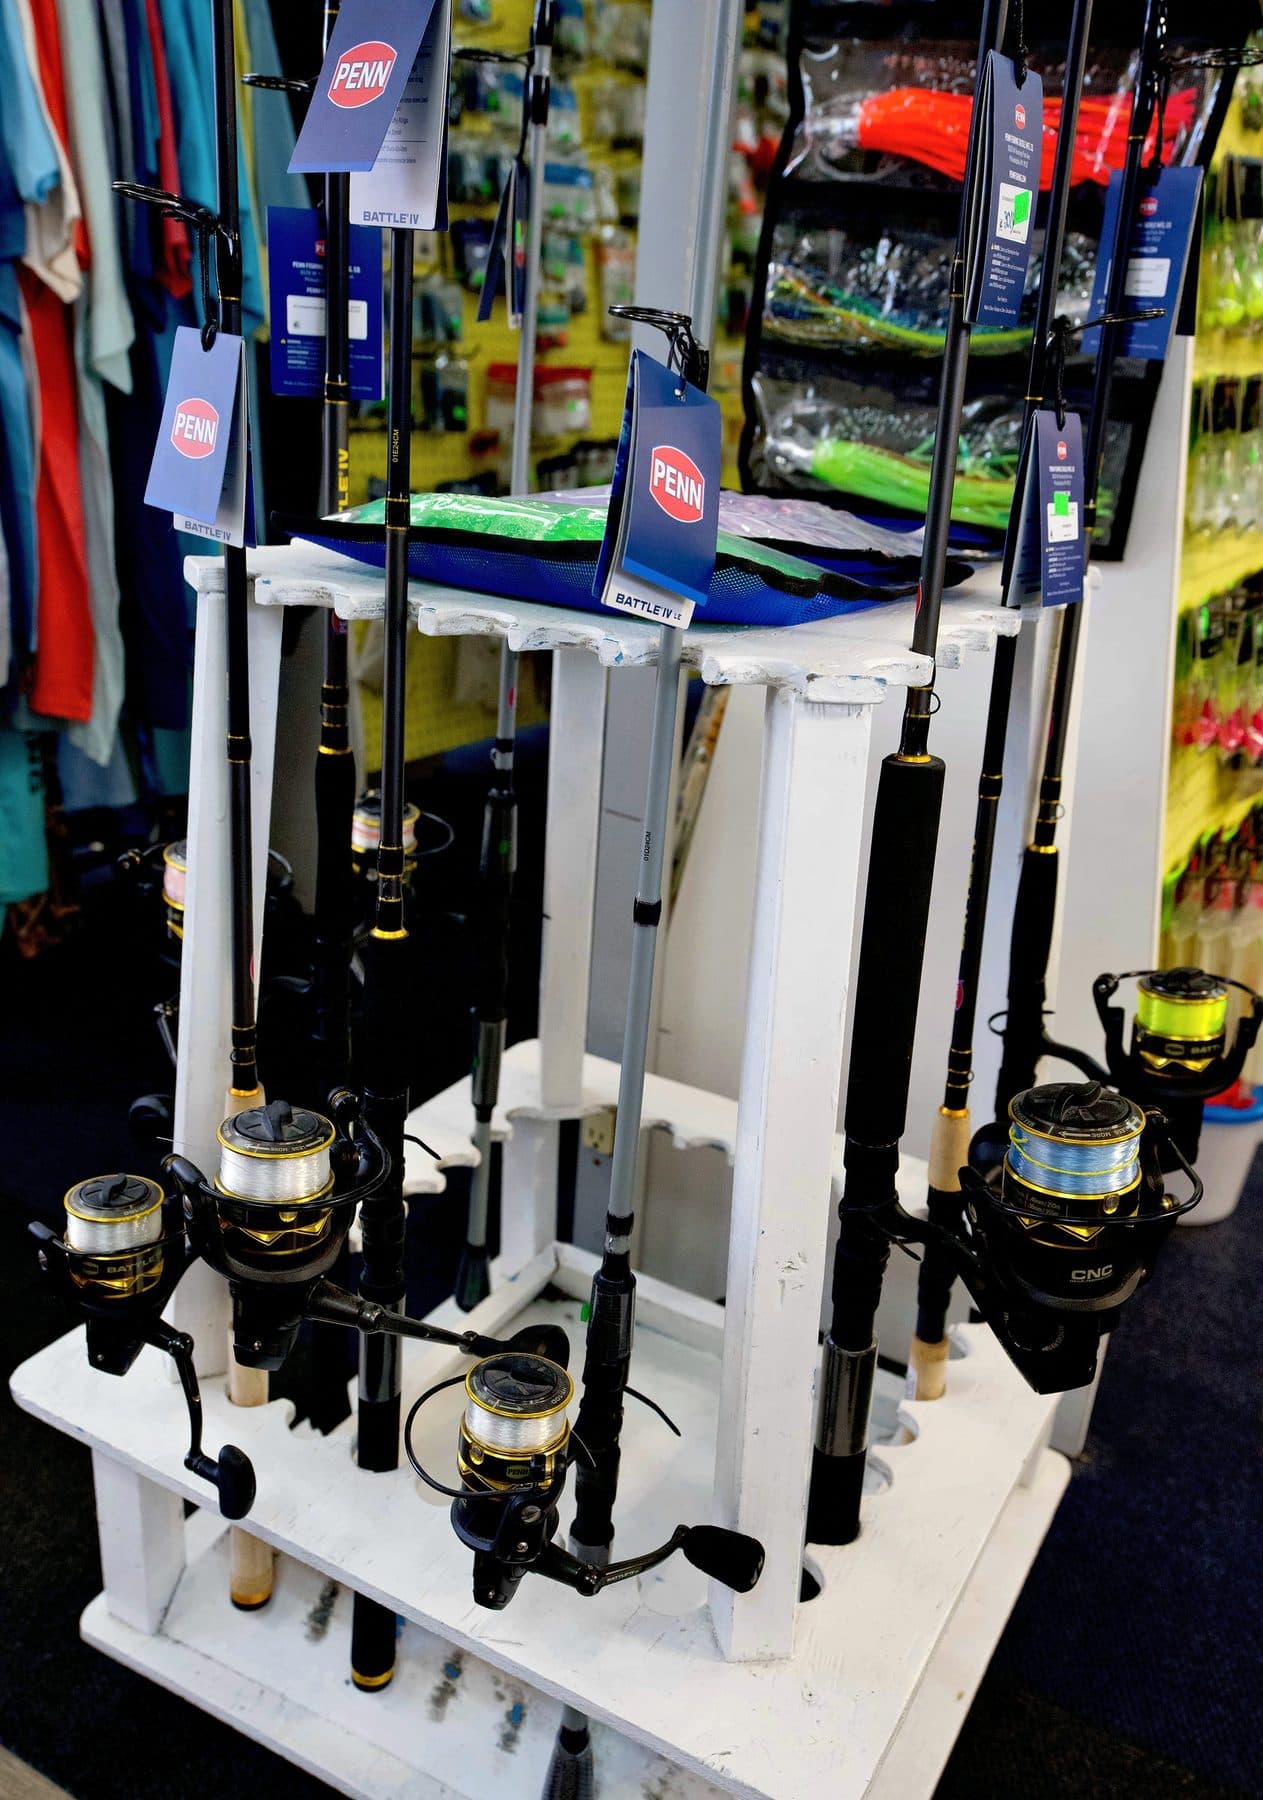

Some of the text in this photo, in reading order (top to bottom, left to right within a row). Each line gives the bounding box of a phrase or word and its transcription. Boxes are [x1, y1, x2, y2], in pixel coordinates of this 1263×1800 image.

[333, 60, 392, 90] PENN
[363, 211, 419, 225] BATTLE IV
[174, 412, 216, 445] PENN
[653, 458, 702, 511] PENN
[184, 520, 231, 541] BATTLE IV
[616, 593, 660, 616] BATTLE
[662, 607, 673, 619] IV
[1071, 1264, 1113, 1280] CNC
